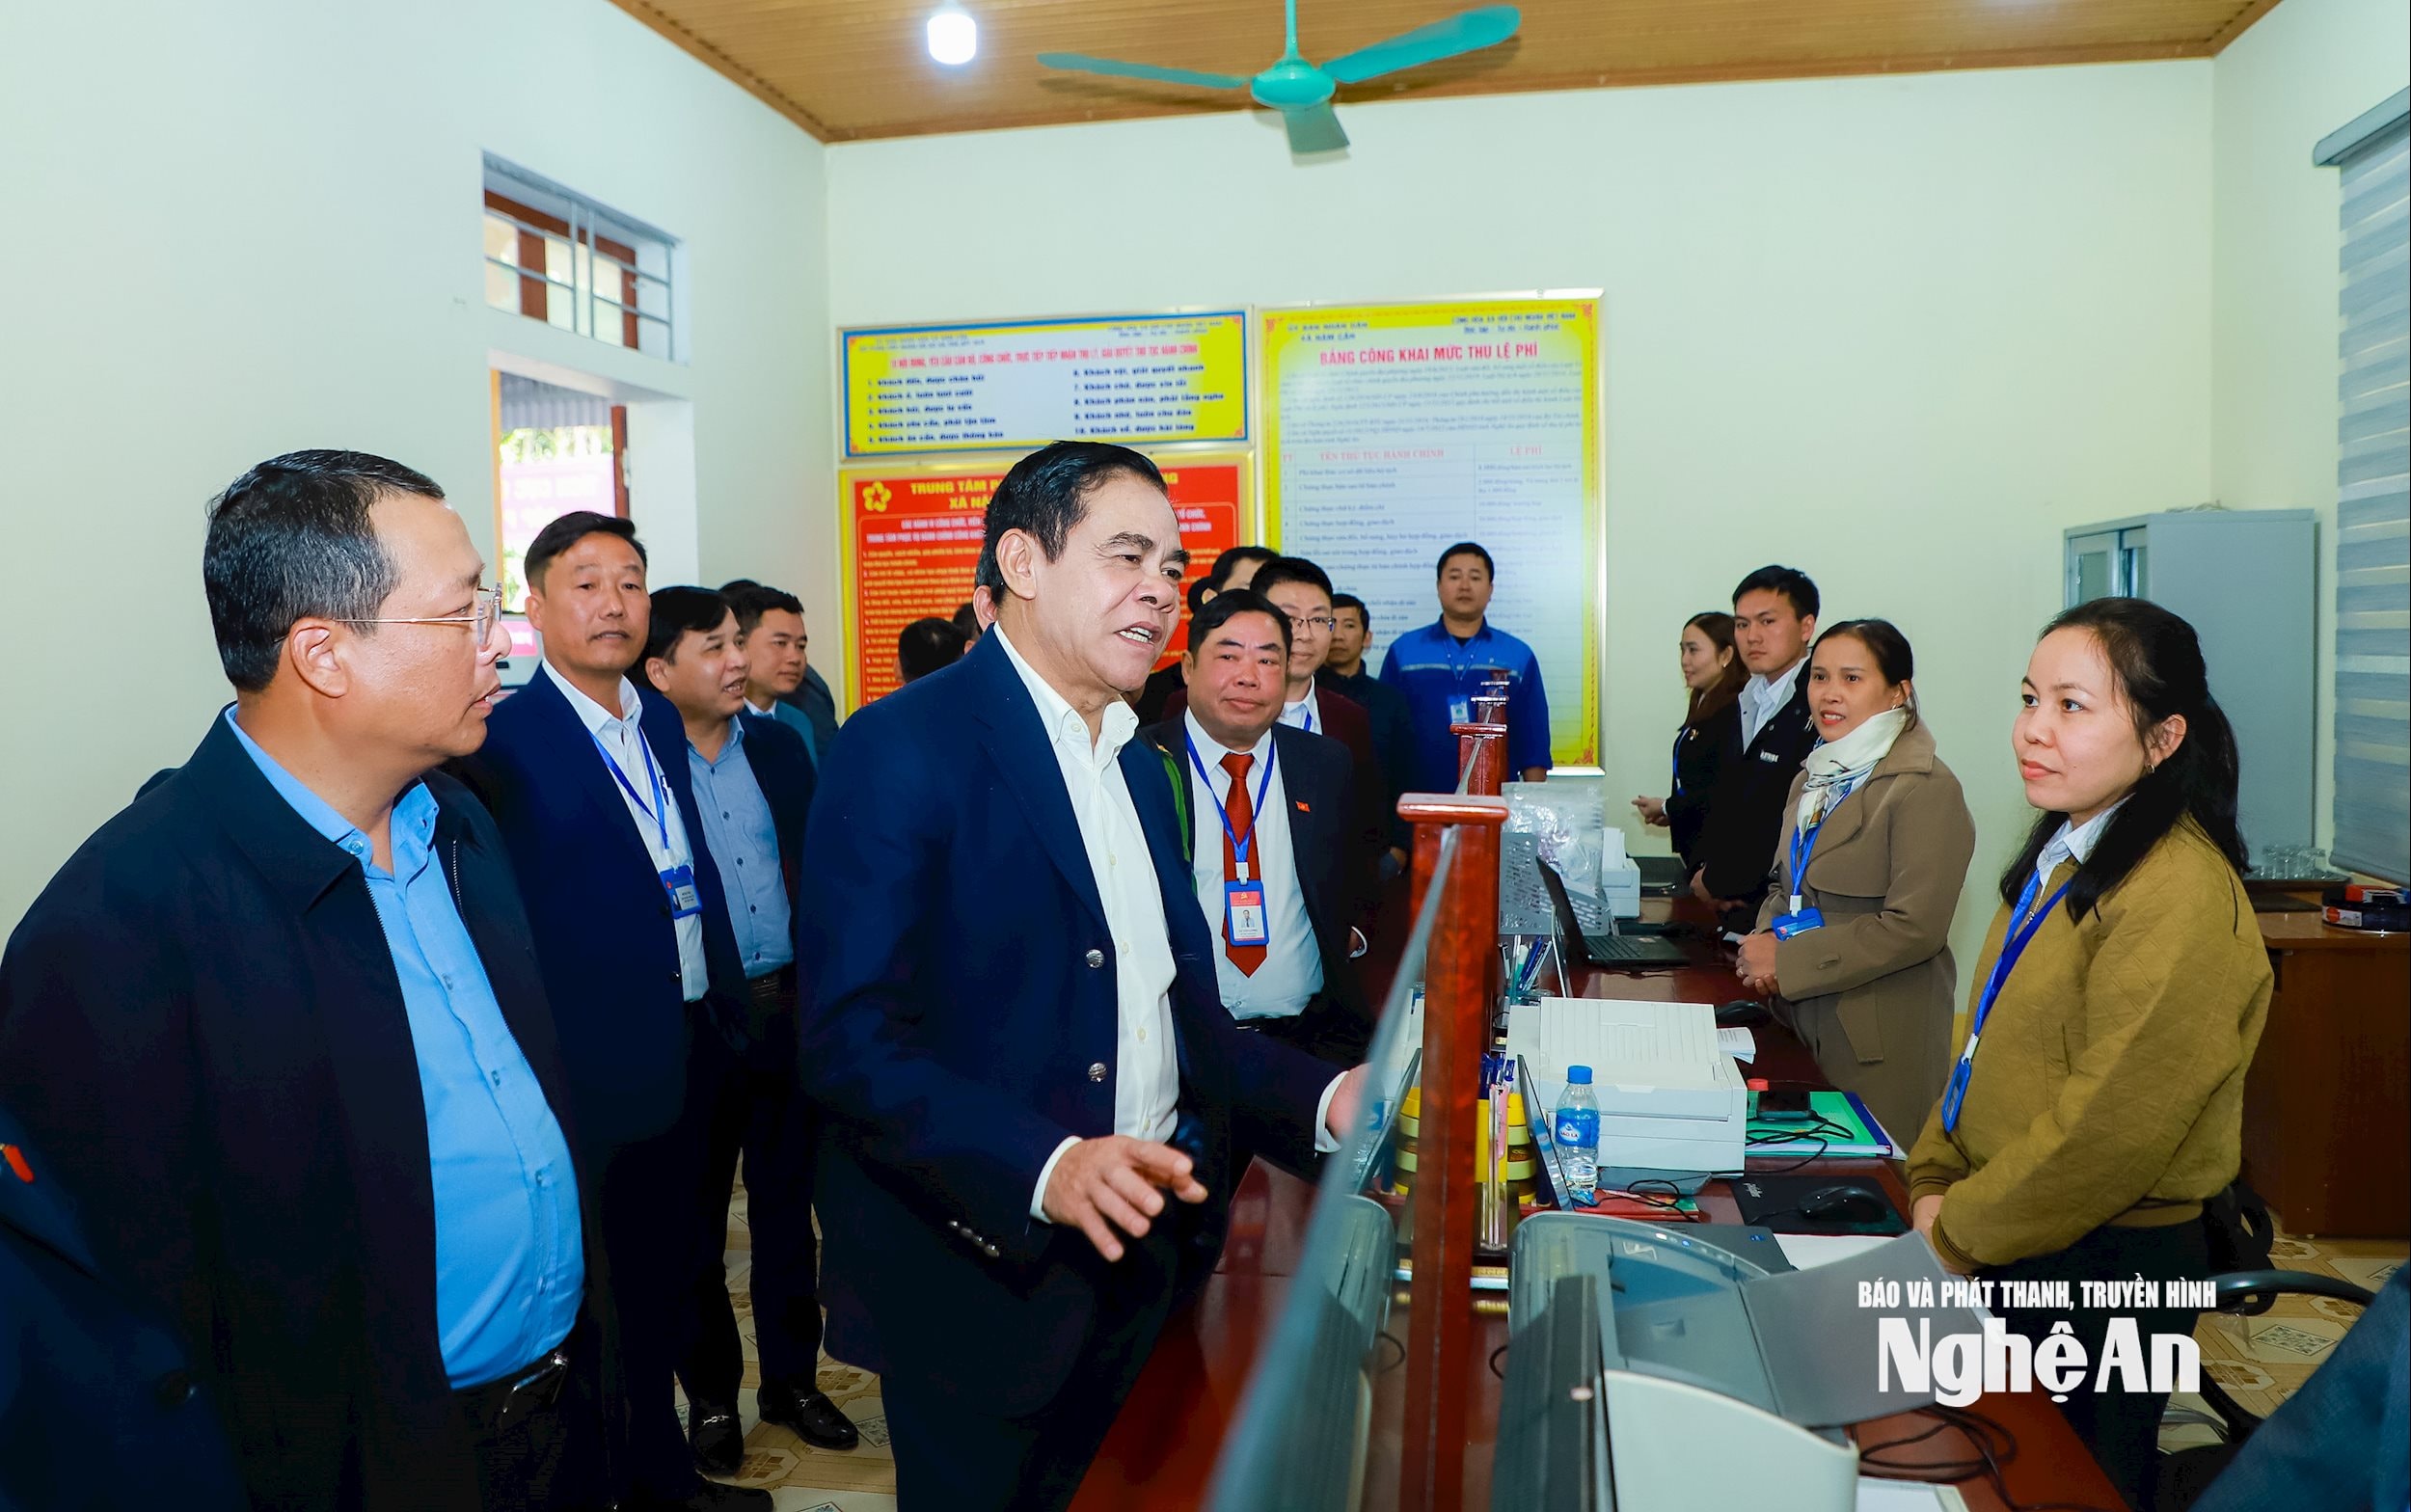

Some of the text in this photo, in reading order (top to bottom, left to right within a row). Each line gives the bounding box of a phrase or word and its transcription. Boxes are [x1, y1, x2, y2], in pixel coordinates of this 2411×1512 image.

[1319, 340, 1538, 365] BẢNG CÔNG KHAI MỨC THU LỆ PHÍ
[910, 480, 955, 495] TRUNG
[957, 478, 988, 493] TÂM
[949, 495, 968, 510] XÃ
